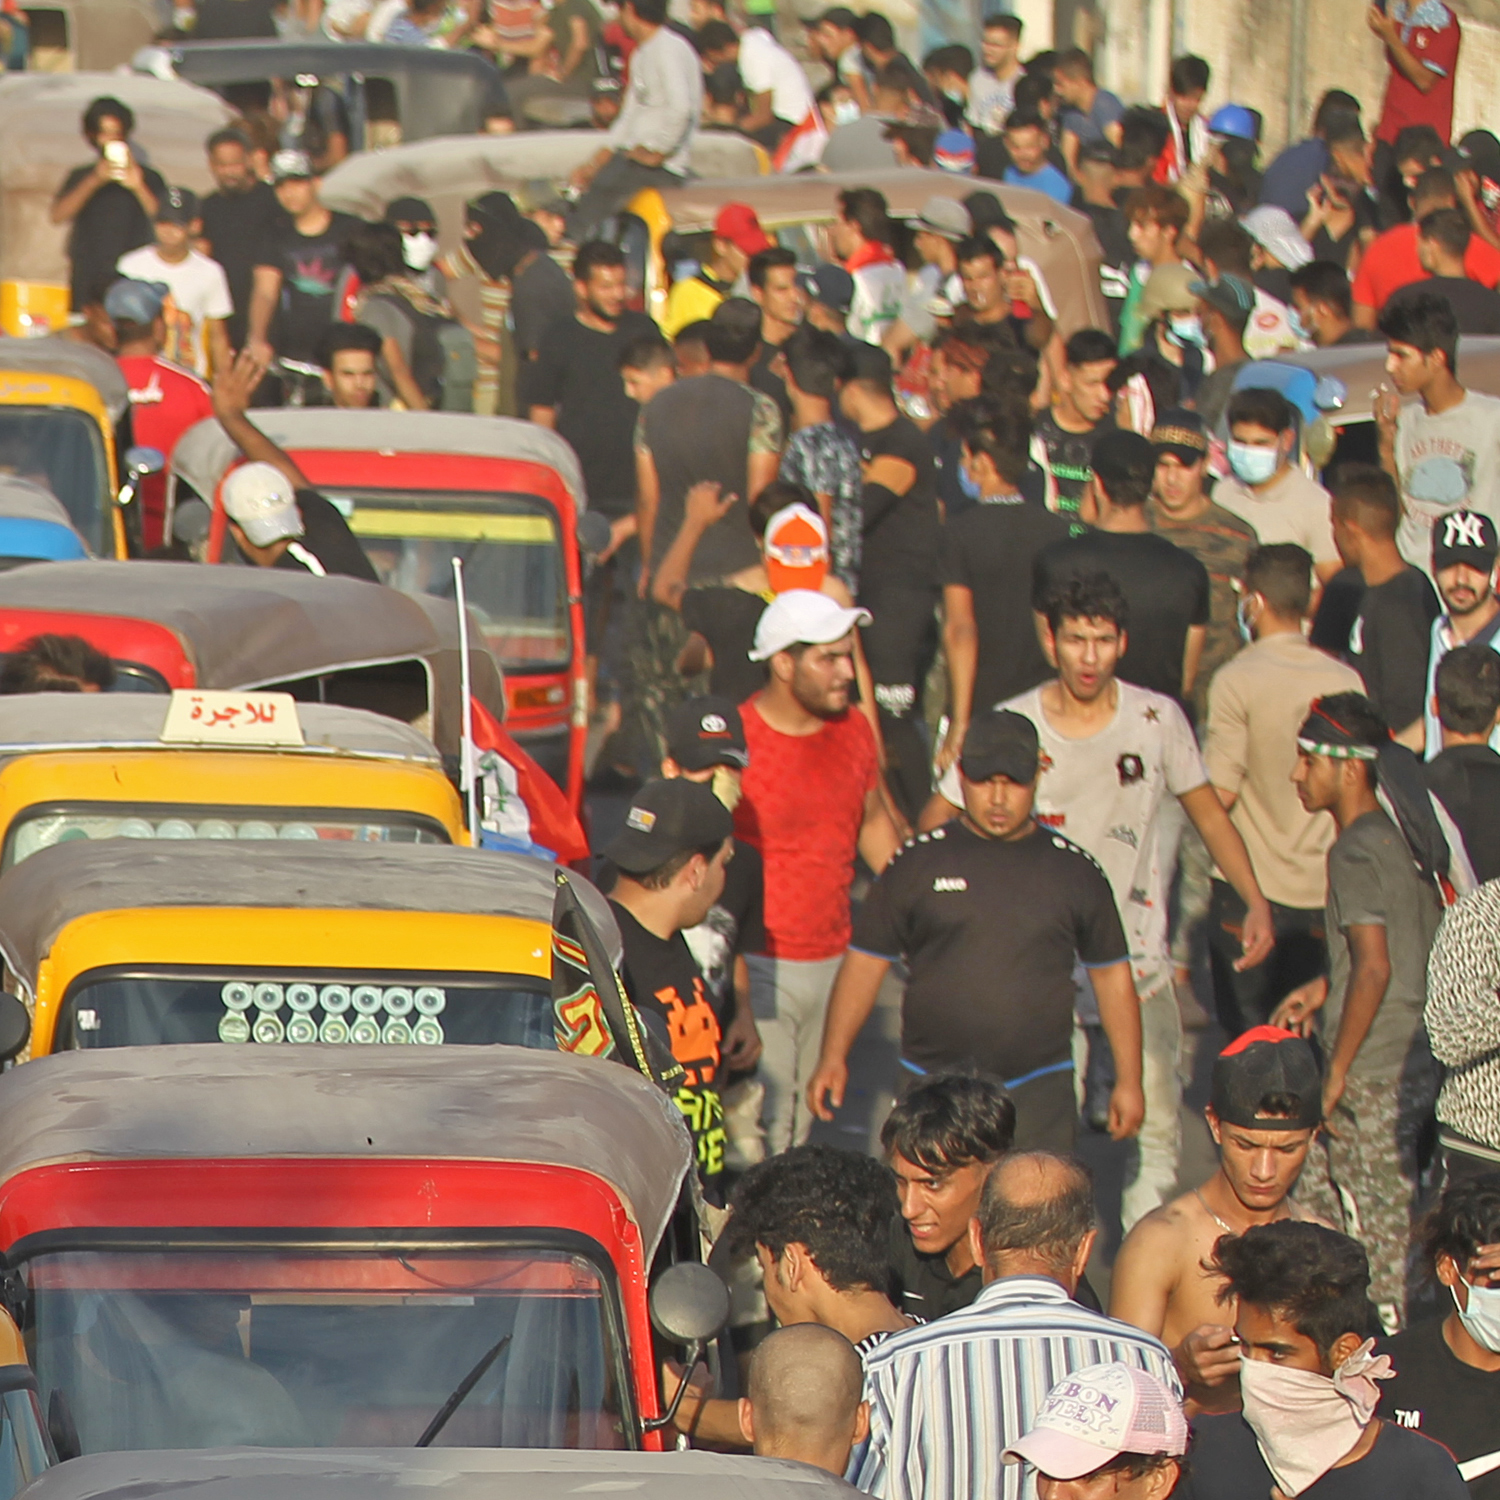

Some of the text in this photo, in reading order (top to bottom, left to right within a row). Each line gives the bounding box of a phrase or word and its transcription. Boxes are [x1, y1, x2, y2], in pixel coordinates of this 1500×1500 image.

[1443, 511, 1485, 548] NY
[190, 696, 276, 728] للاجرة
[1394, 1409, 1421, 1429] TM
